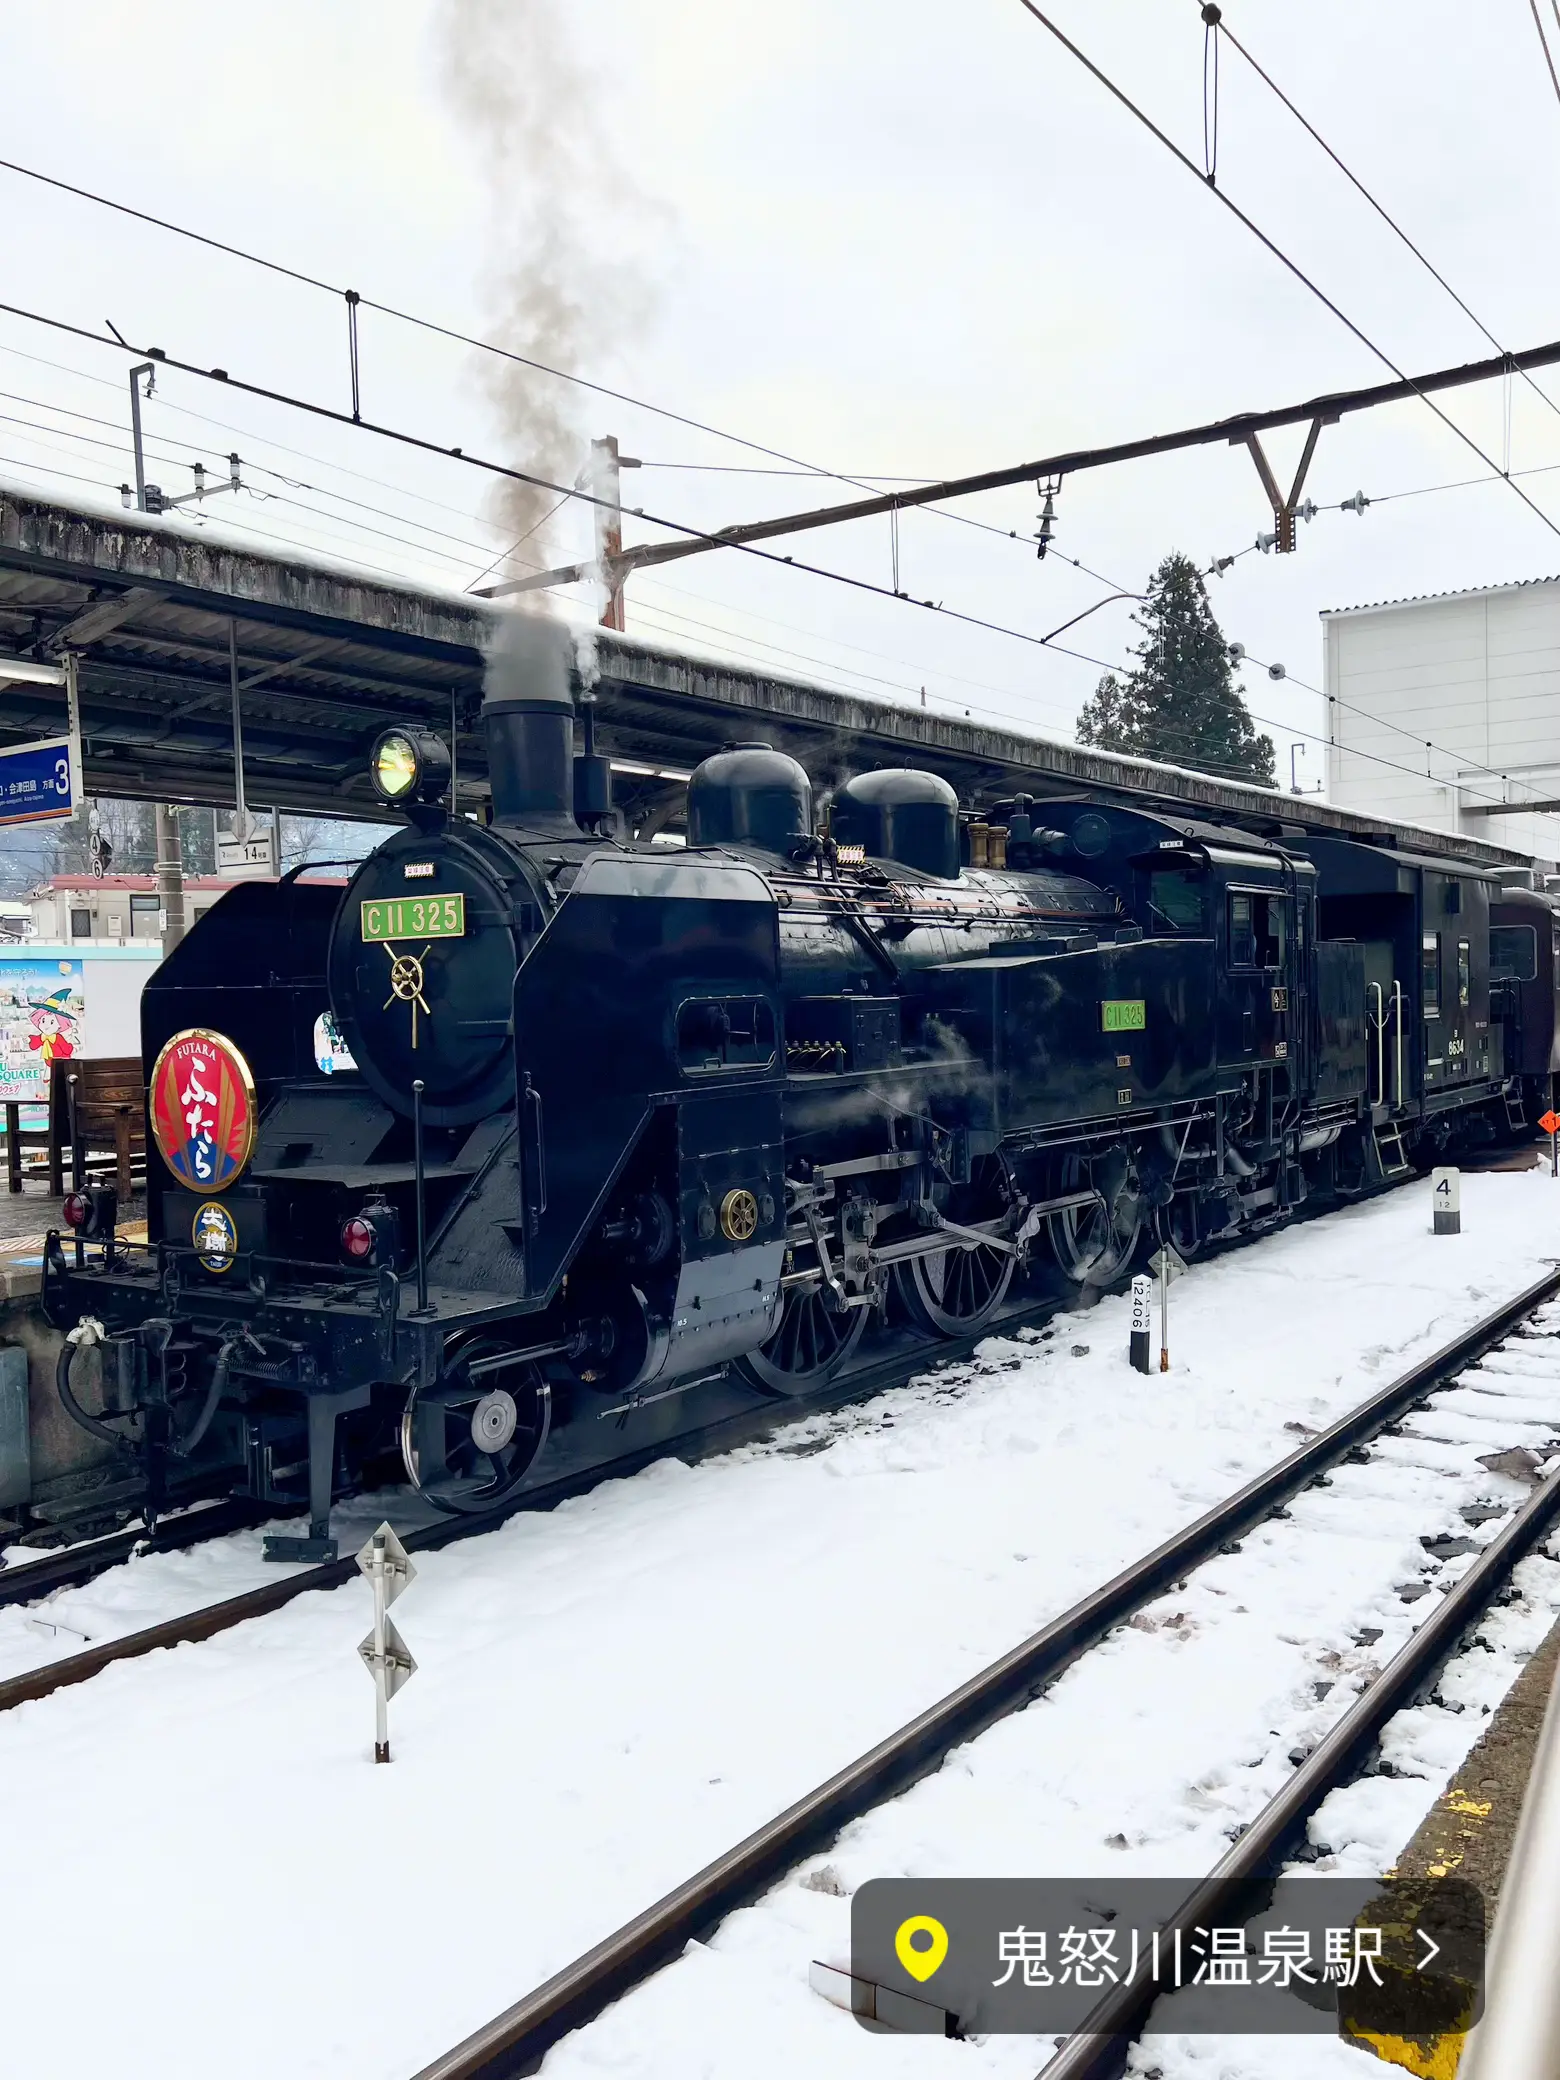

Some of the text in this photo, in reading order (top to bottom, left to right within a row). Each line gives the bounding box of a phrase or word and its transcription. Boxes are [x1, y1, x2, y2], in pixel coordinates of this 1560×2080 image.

[55, 759, 69, 795] 3
[92, 836, 98, 853] 4
[95, 860, 101, 878] 6
[412, 900, 457, 932] 325
[1124, 1004, 1143, 1025] 325
[177, 1042, 217, 1061] FUTARA
[1448, 1039, 1464, 1055] 8634
[181, 1056, 218, 1179] ふたら
[1436, 1178, 1451, 1196] 4
[1439, 1201, 1450, 1209] 12
[201, 1207, 227, 1262] 大樹
[1132, 1281, 1144, 1328] 12406
